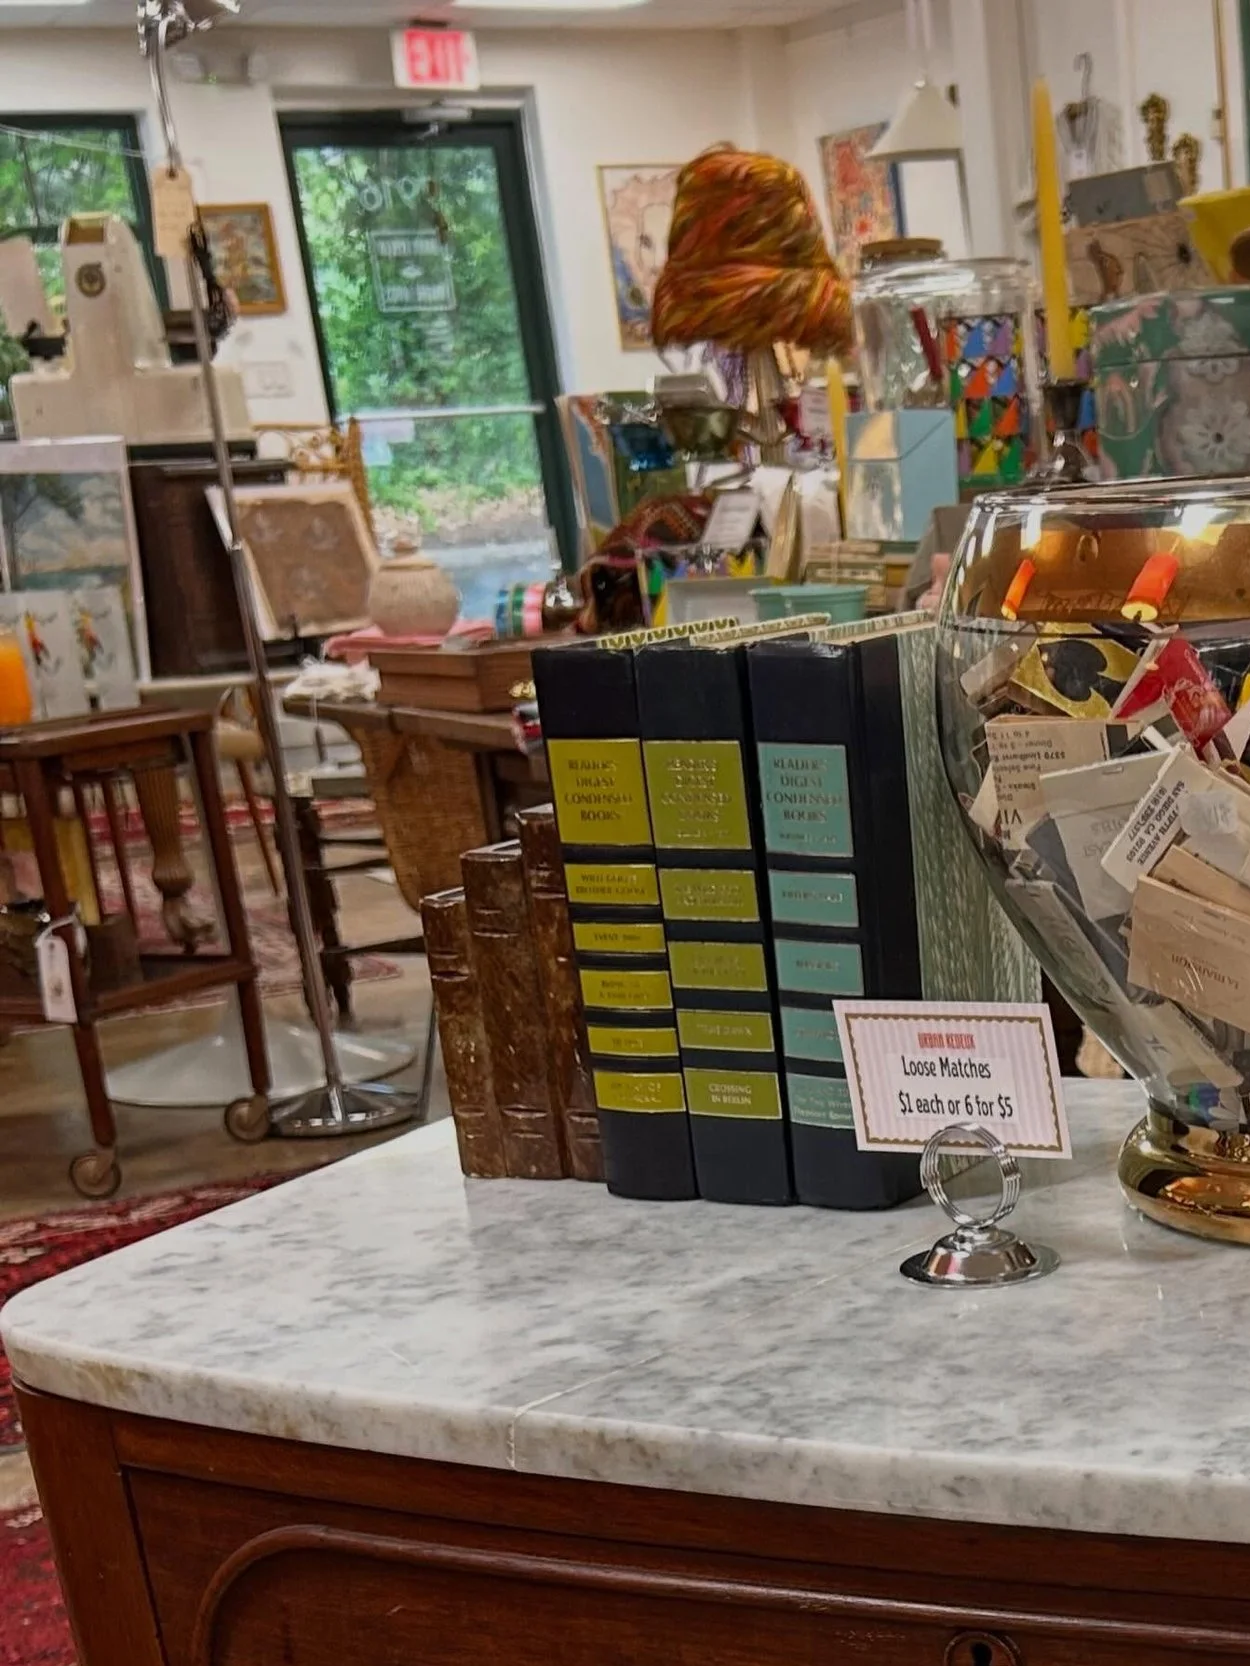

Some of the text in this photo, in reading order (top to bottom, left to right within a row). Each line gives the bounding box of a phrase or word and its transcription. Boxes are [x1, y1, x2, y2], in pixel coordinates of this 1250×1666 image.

[1170, 779, 1186, 798] SAN
[580, 808, 621, 822] BOOKS
[783, 808, 828, 823] BOOKS
[901, 1055, 991, 1079] Loose Matches
[899, 1090, 1013, 1119] $1 each or 6 for $5
